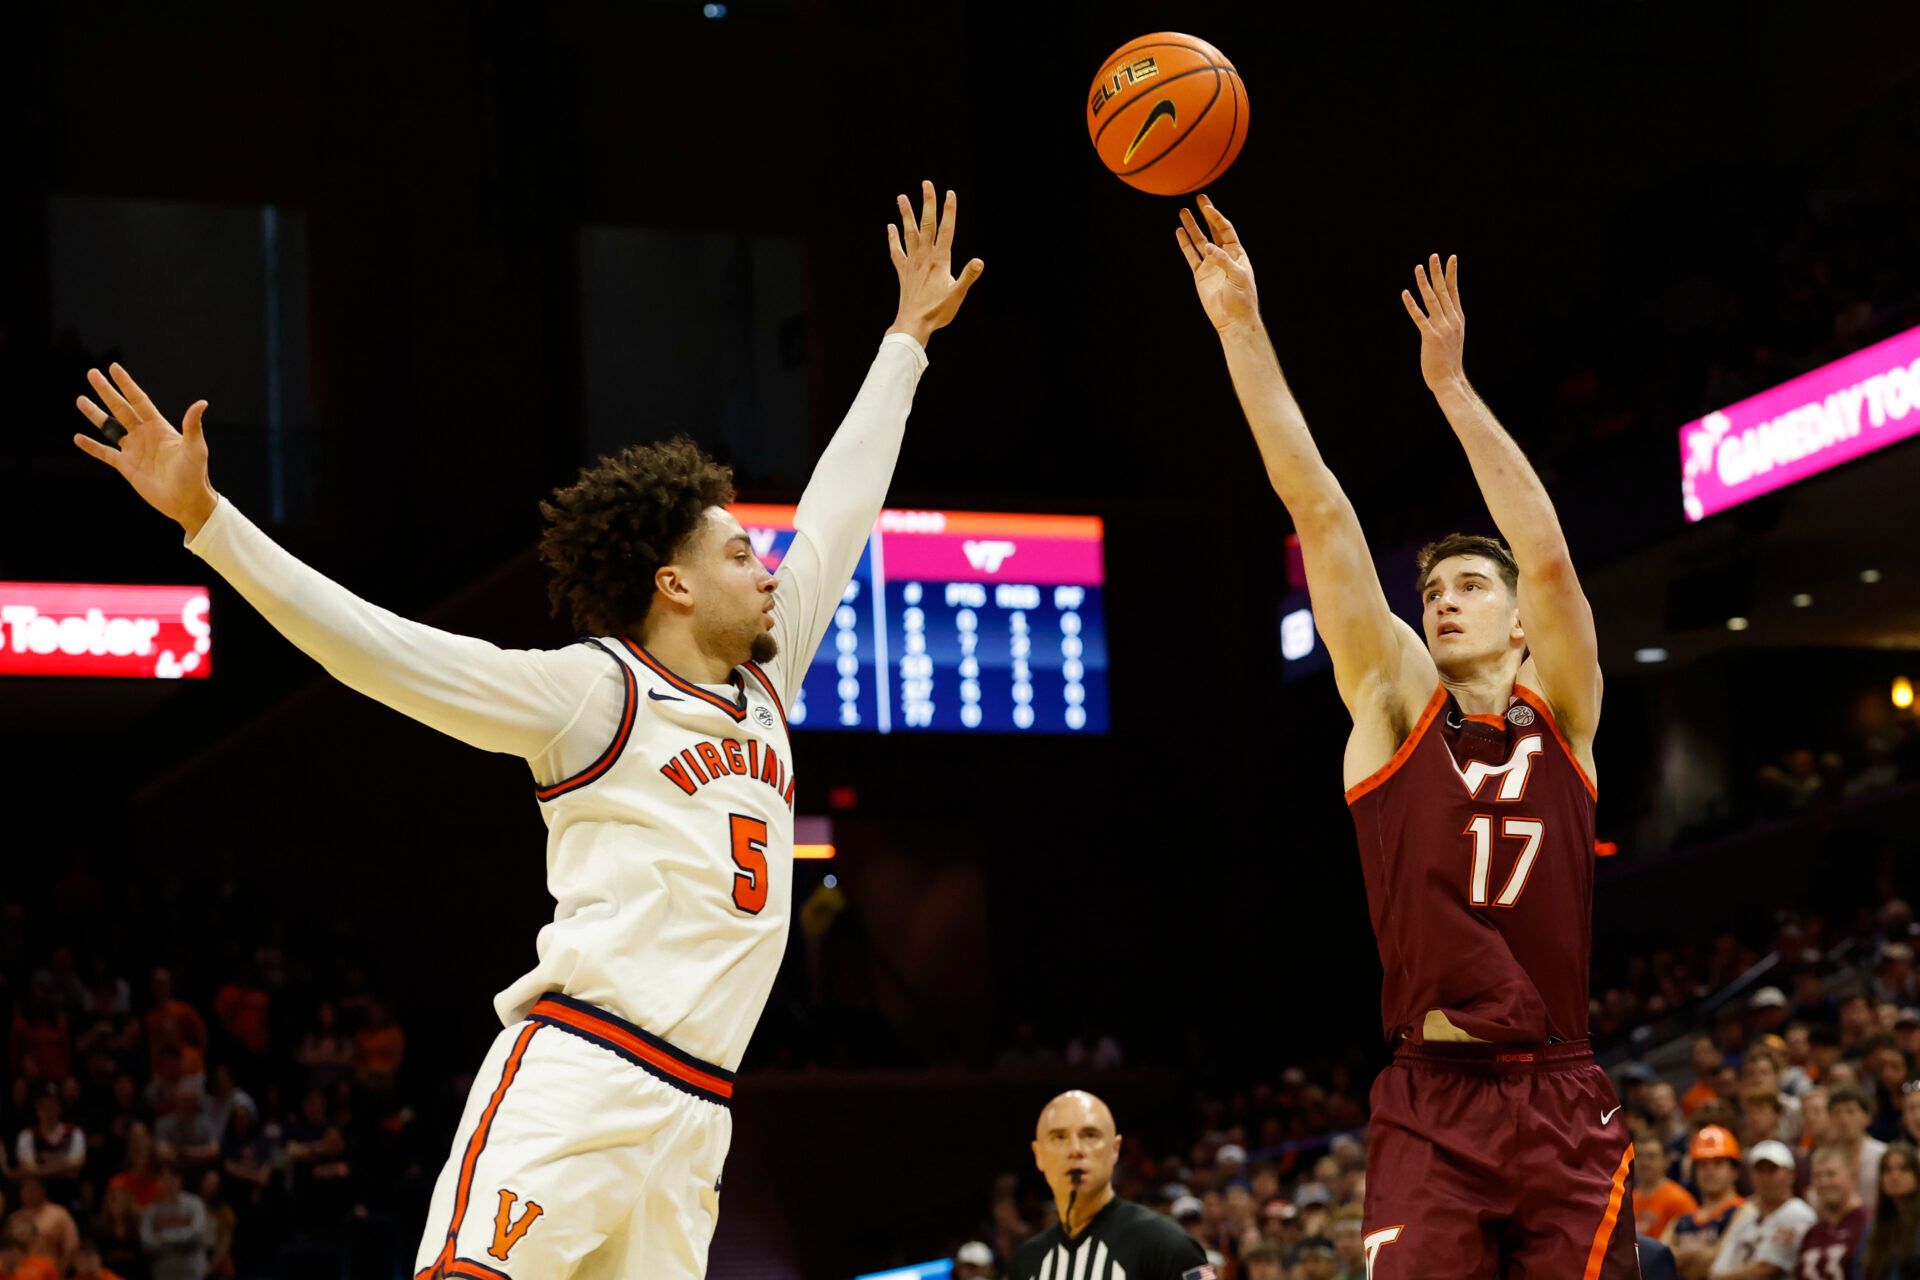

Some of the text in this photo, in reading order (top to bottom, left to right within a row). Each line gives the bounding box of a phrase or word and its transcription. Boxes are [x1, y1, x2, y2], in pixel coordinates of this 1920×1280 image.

[1091, 57, 1159, 117] ELITE
[729, 812, 768, 915] 5
[1463, 814, 1545, 908] 17
[487, 1188, 544, 1261] V
